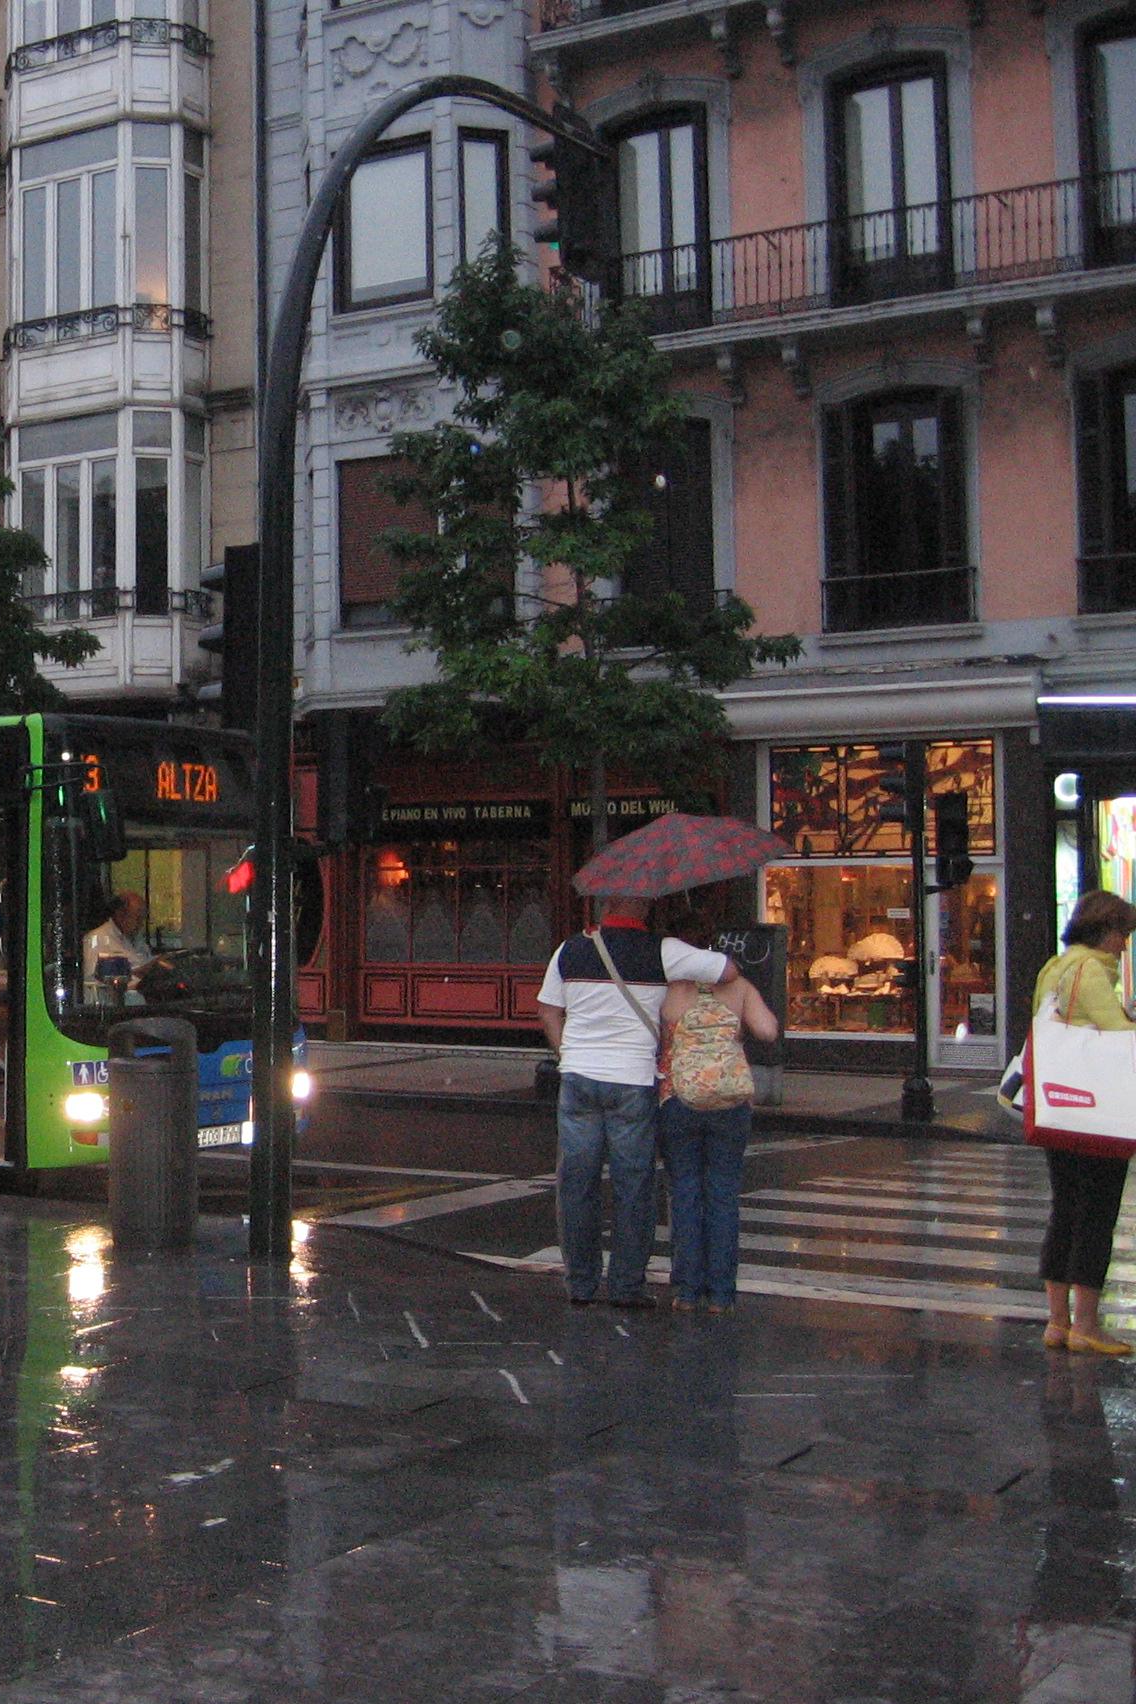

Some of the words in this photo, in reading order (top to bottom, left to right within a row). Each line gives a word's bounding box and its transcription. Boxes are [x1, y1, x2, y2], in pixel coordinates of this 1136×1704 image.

[157, 761, 219, 802] ALTZA
[390, 808, 422, 821] PIANO
[423, 807, 438, 820] EN
[442, 807, 466, 820] VIVO
[474, 805, 532, 819] TABERNA
[620, 800, 646, 815] DEL
